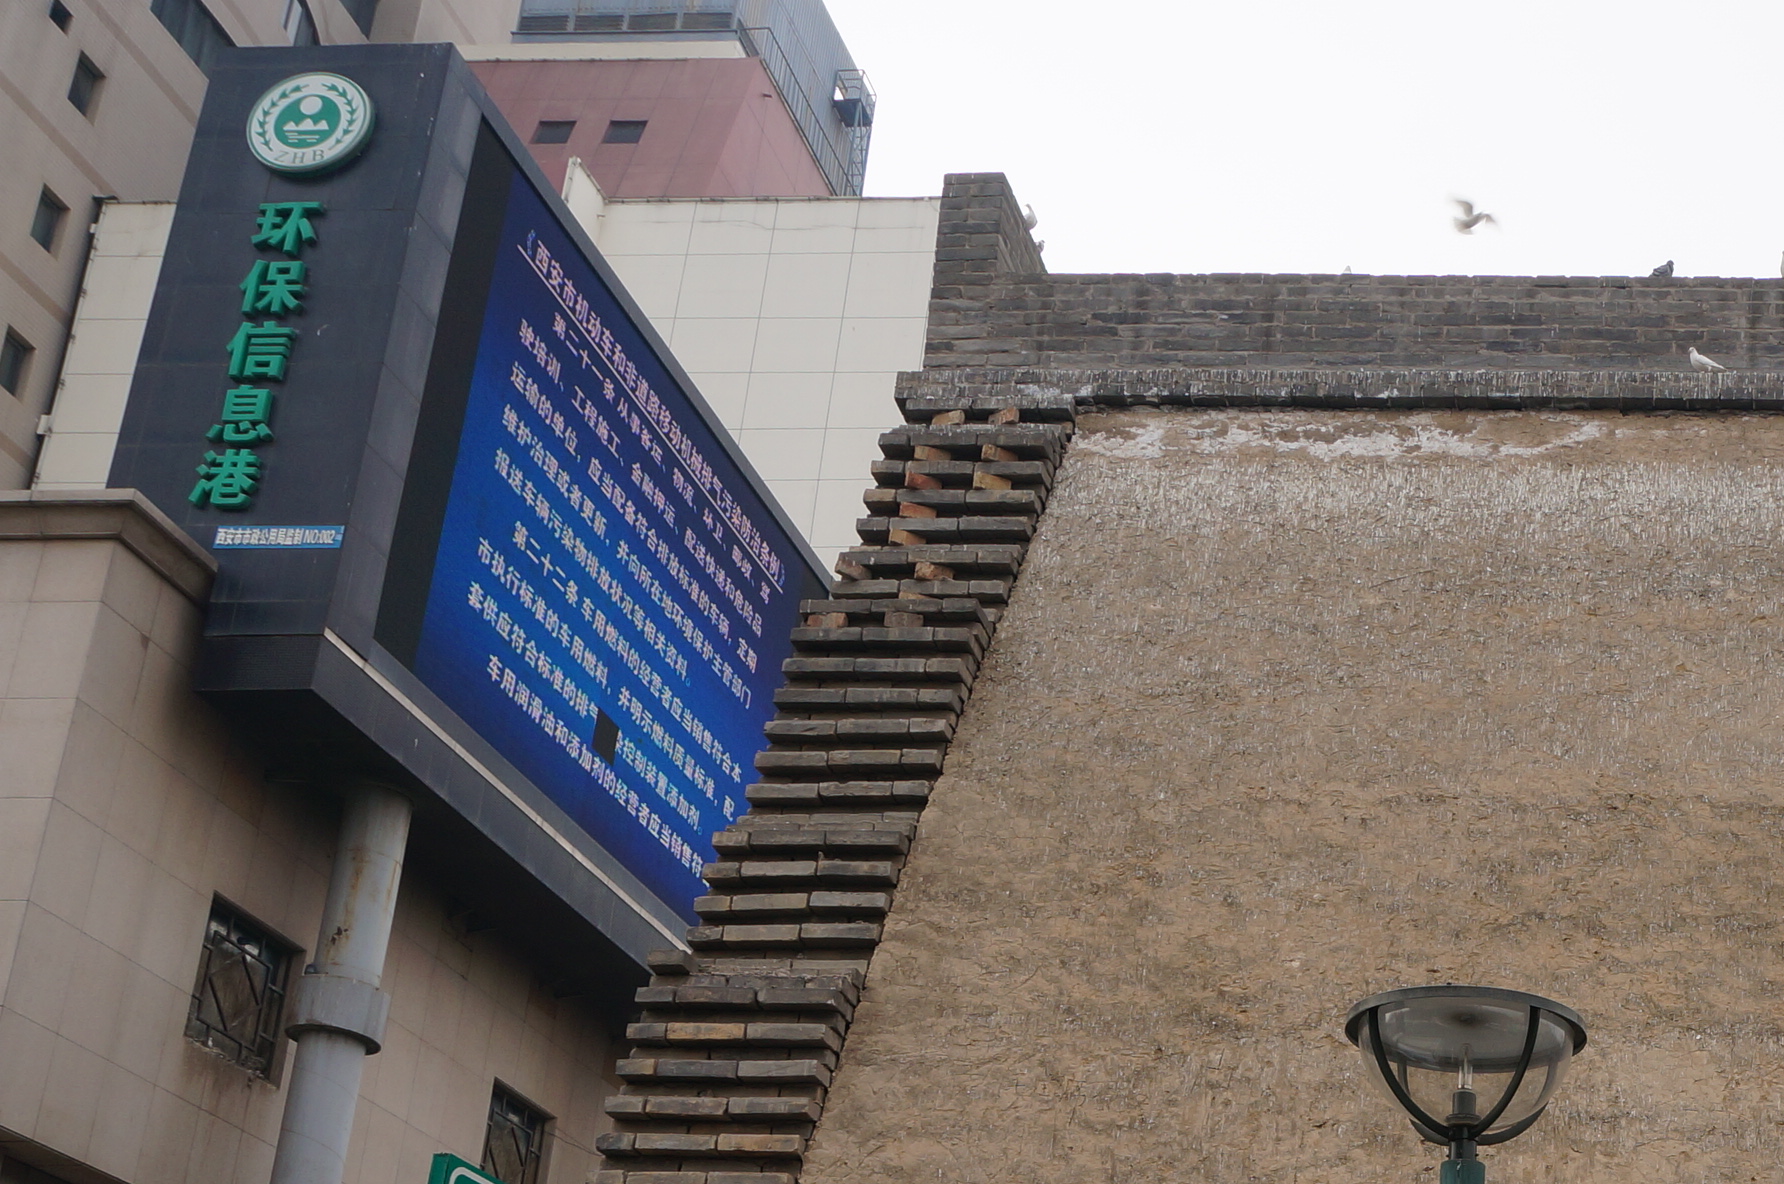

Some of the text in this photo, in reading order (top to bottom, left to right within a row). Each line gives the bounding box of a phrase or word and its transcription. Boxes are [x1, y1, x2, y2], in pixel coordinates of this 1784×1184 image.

[273, 149, 325, 164] ZHB
[188, 201, 325, 511] 环保信息港
[551, 309, 615, 407] 第二十一条
[511, 517, 580, 611] 第二十二条
[485, 650, 713, 888] 车用润滑油和添加剂的经营者应当销售符
